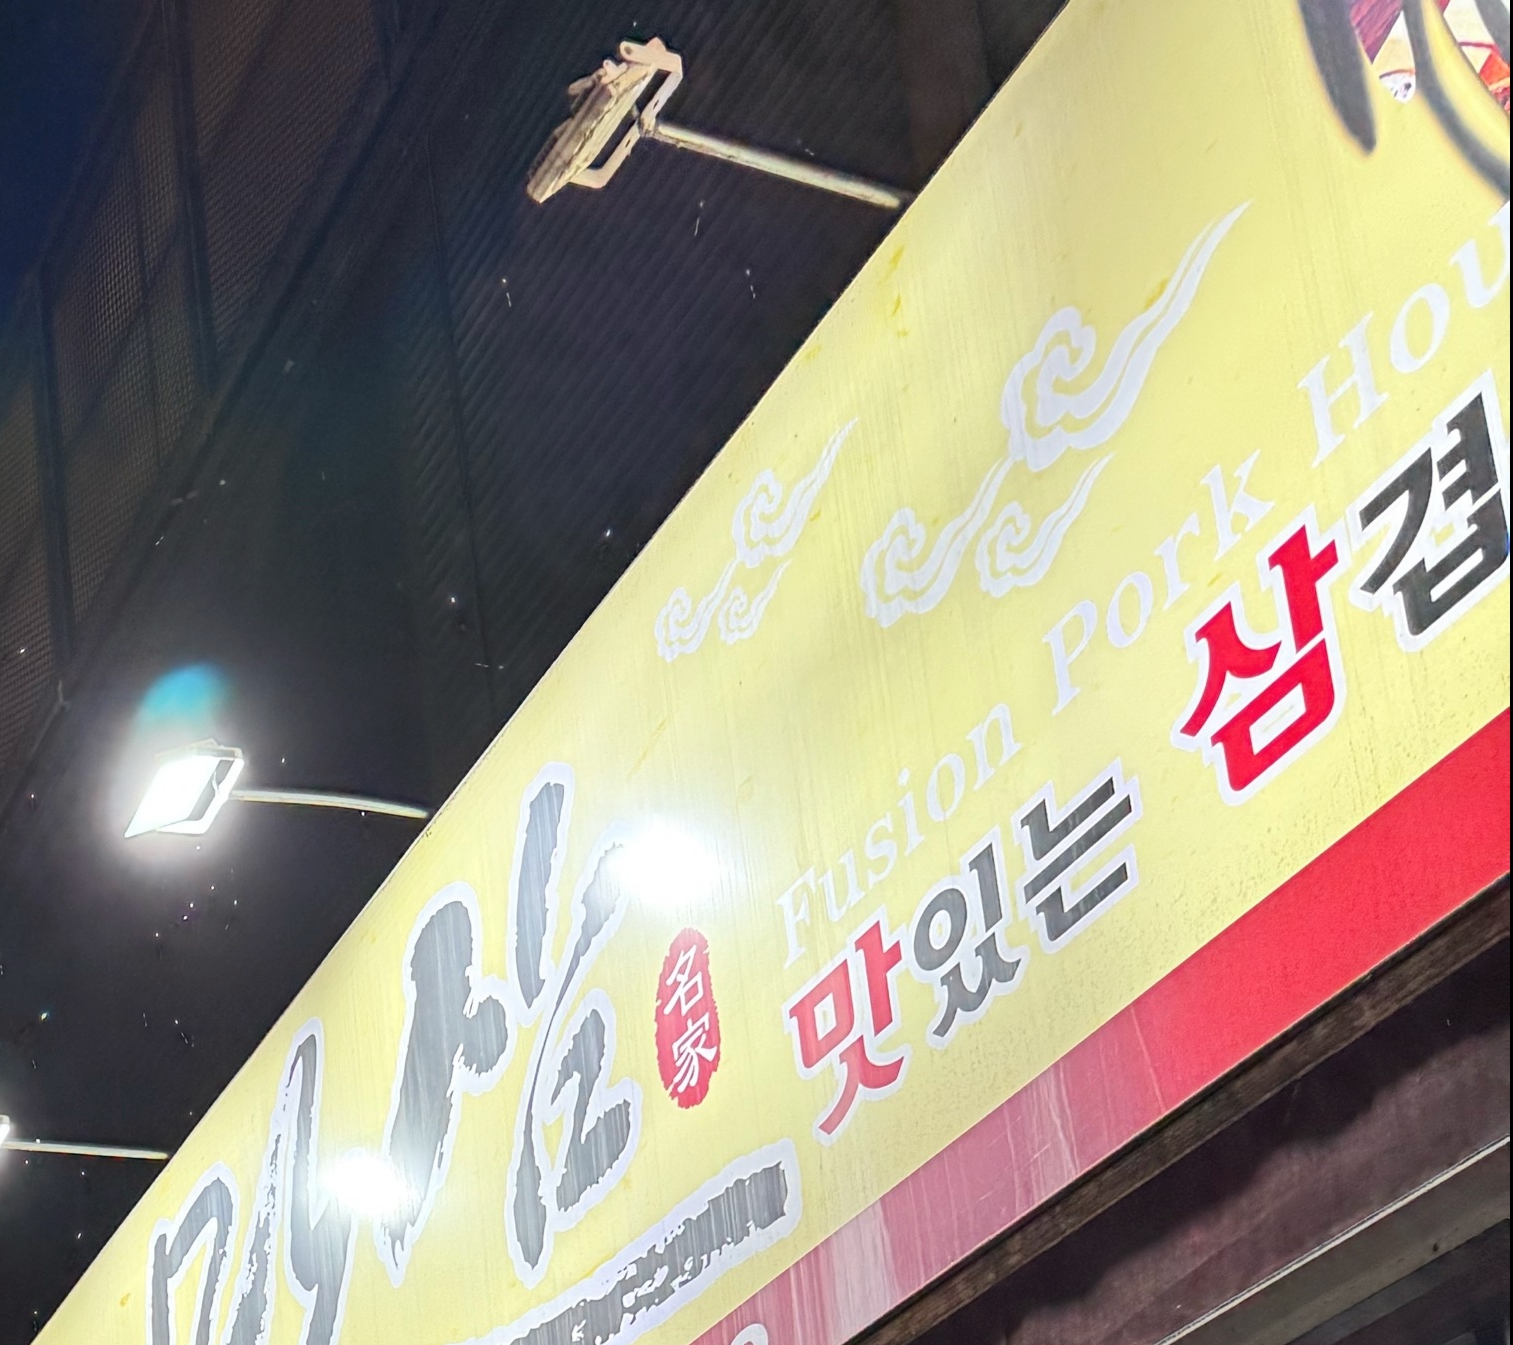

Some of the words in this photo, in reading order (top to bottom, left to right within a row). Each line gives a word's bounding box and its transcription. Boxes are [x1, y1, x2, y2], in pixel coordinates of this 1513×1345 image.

[780, 708, 1021, 967] Fusion
[1050, 447, 1274, 719] Pork
[789, 773, 1135, 1138] 맛있는
